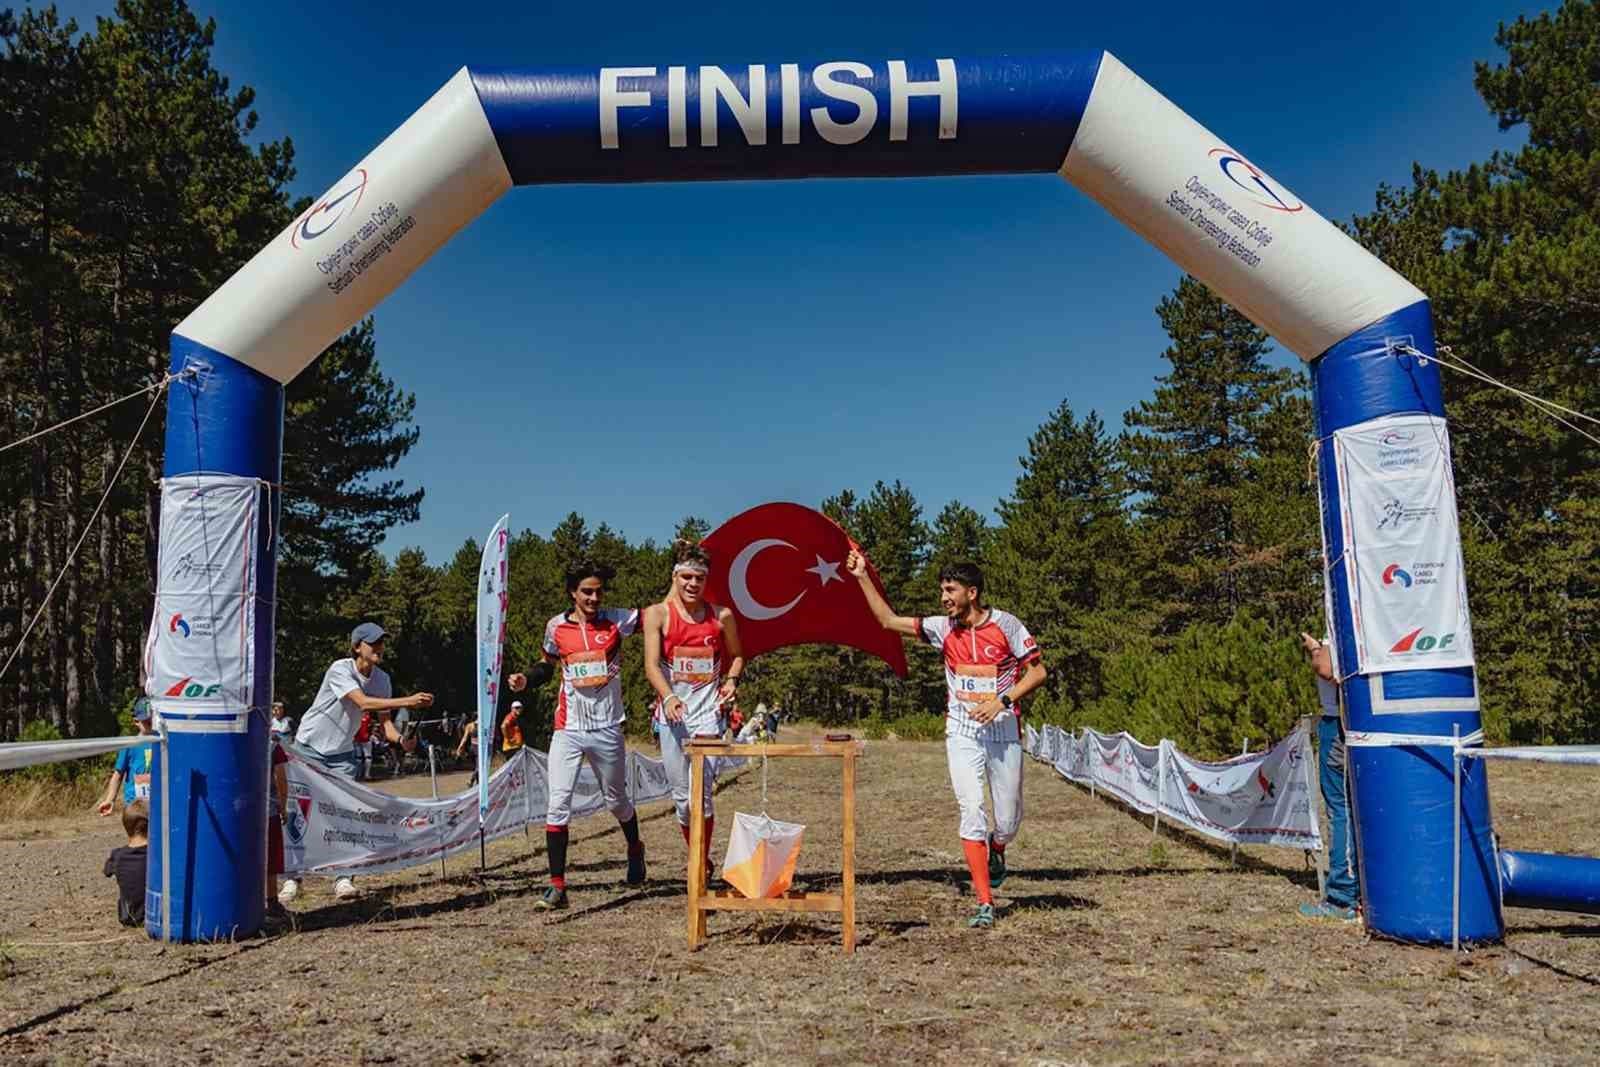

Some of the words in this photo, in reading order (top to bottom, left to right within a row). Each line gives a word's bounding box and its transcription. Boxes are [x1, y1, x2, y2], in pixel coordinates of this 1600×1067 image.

[600, 58, 958, 150] FINISH
[1166, 190, 1194, 218] Serbian
[574, 665, 588, 677] 16
[680, 660, 693, 671] 16
[961, 679, 975, 690] 16
